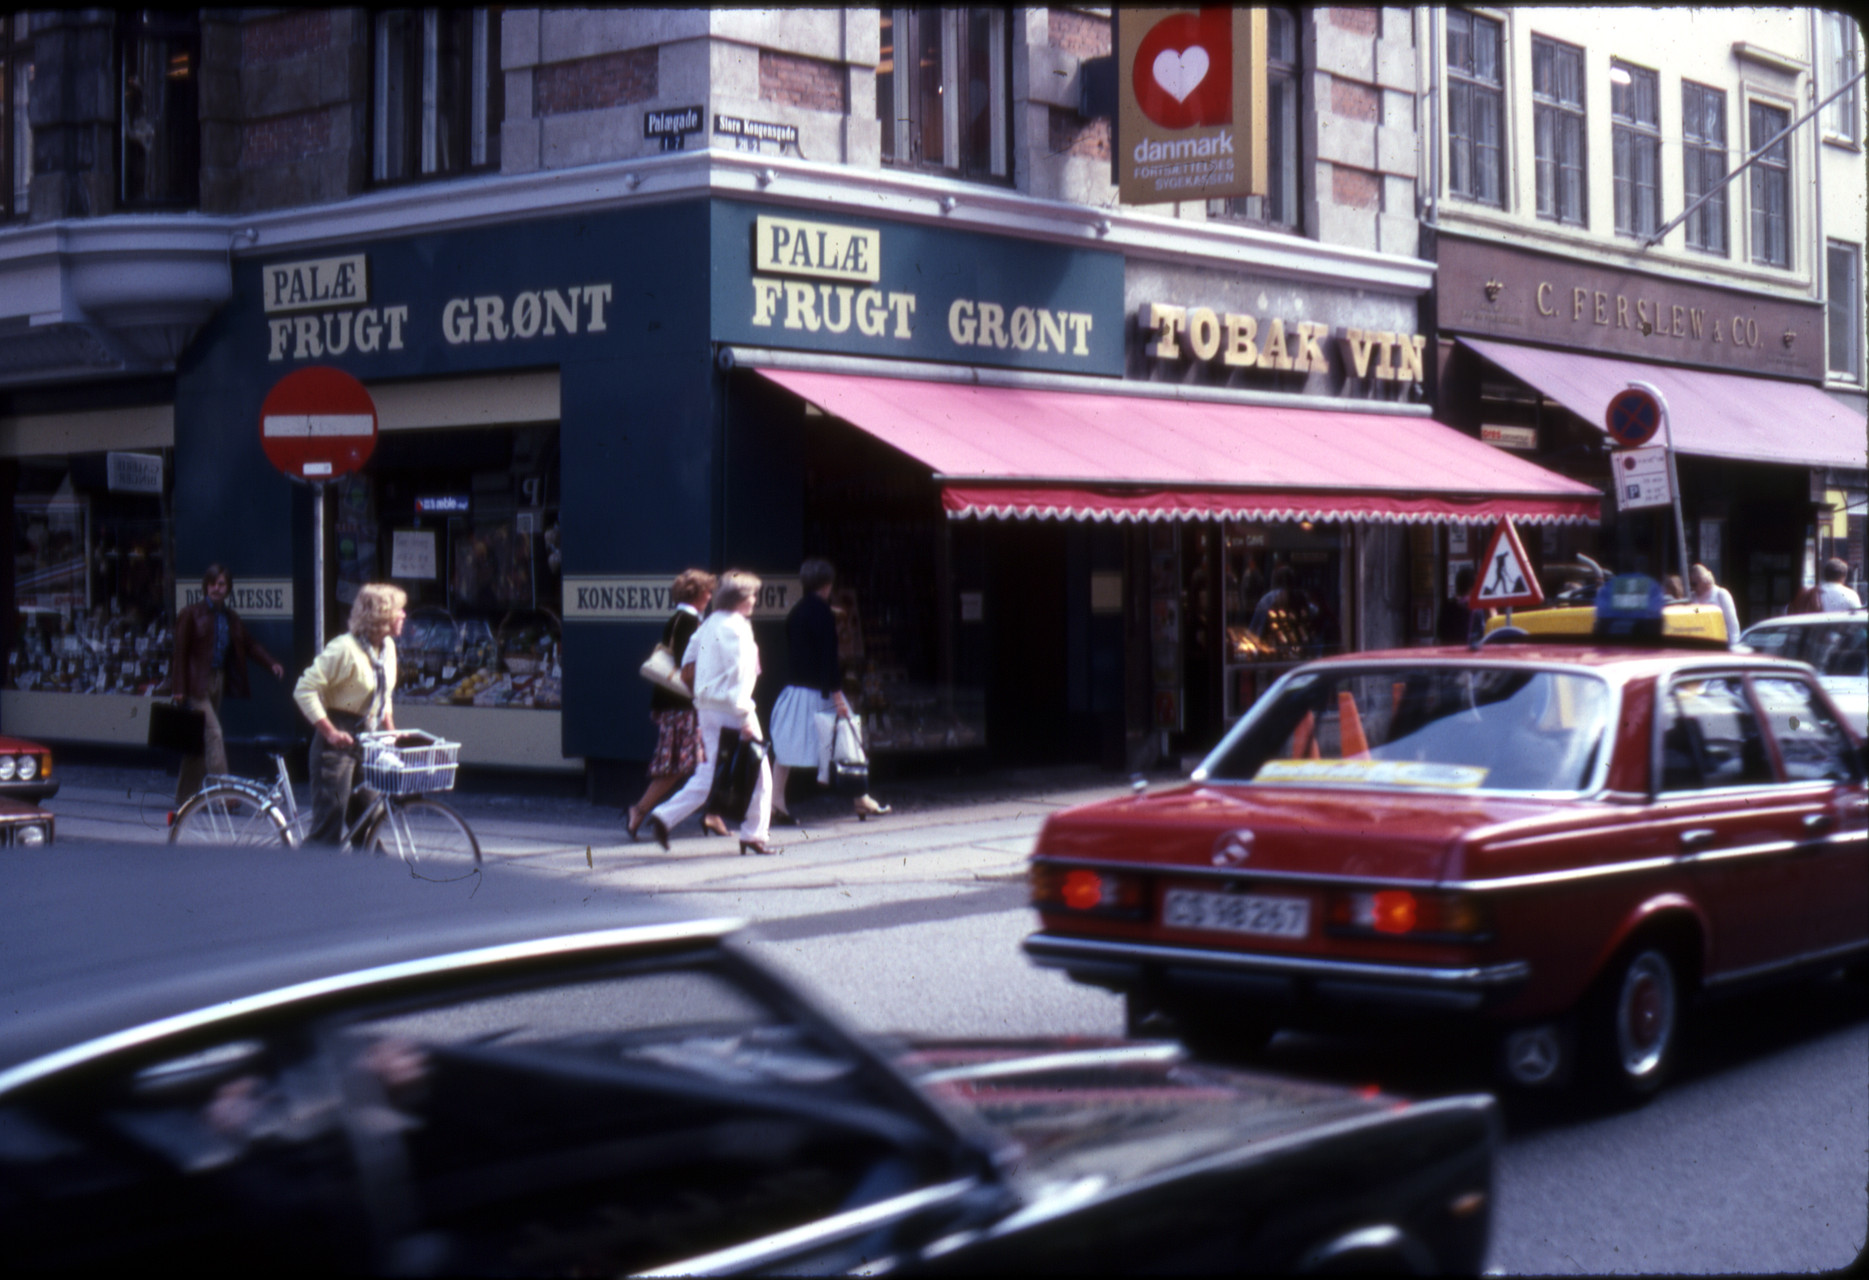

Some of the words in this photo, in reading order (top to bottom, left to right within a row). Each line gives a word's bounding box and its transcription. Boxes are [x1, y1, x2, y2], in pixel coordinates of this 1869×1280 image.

[648, 107, 698, 134] Palægade
[1134, 130, 1233, 163] danmark
[1155, 171, 1234, 191] SYGEKASSEN
[770, 224, 868, 273] PALÆ
[273, 263, 356, 305] PALÆ
[268, 305, 408, 361] FRUGT
[442, 284, 612, 344] GRØNT
[752, 277, 916, 339] FRUGT
[948, 299, 1092, 356] GRØNT
[1536, 281, 1560, 318] C.
[1573, 286, 1705, 340] FERSLEW
[1731, 315, 1764, 349] CO.
[1147, 302, 1329, 374] TOBAK
[1344, 325, 1426, 382] VIN
